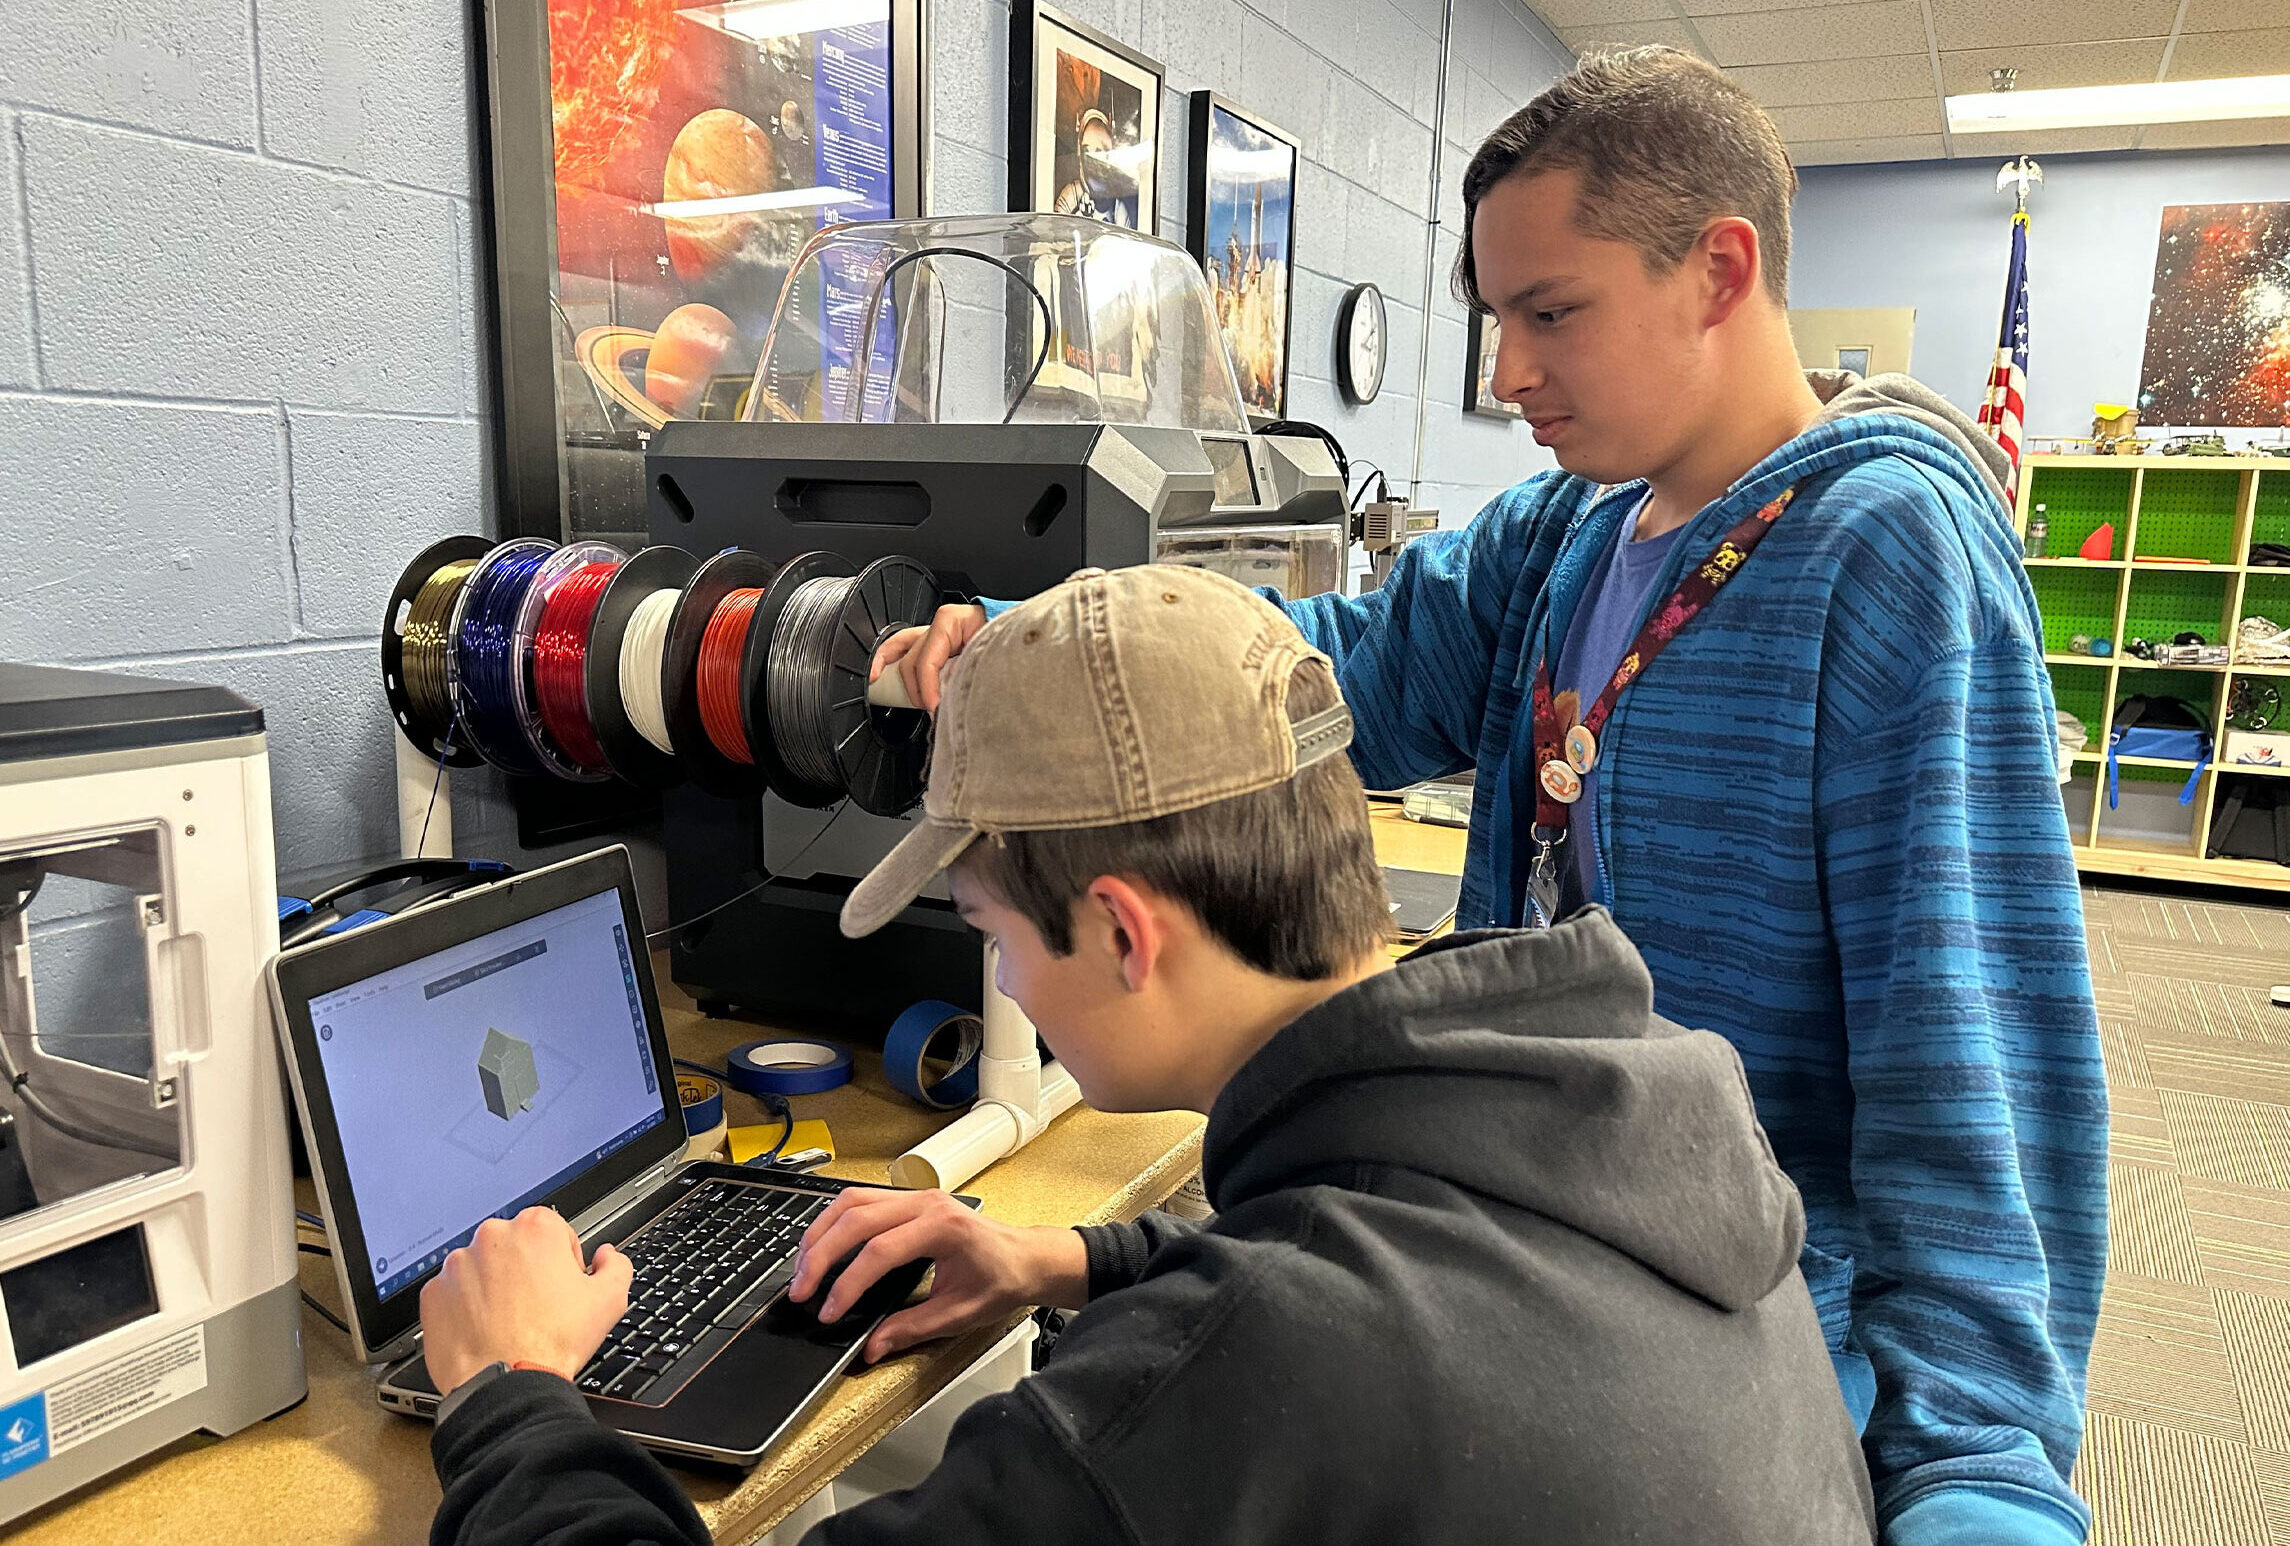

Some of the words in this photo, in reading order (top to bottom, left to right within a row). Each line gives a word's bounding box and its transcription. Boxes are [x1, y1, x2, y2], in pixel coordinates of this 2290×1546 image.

[822, 40, 845, 64] Mercury
[822, 123, 840, 142] Venus
[824, 206, 839, 224] Earth
[826, 283, 841, 299] Mars
